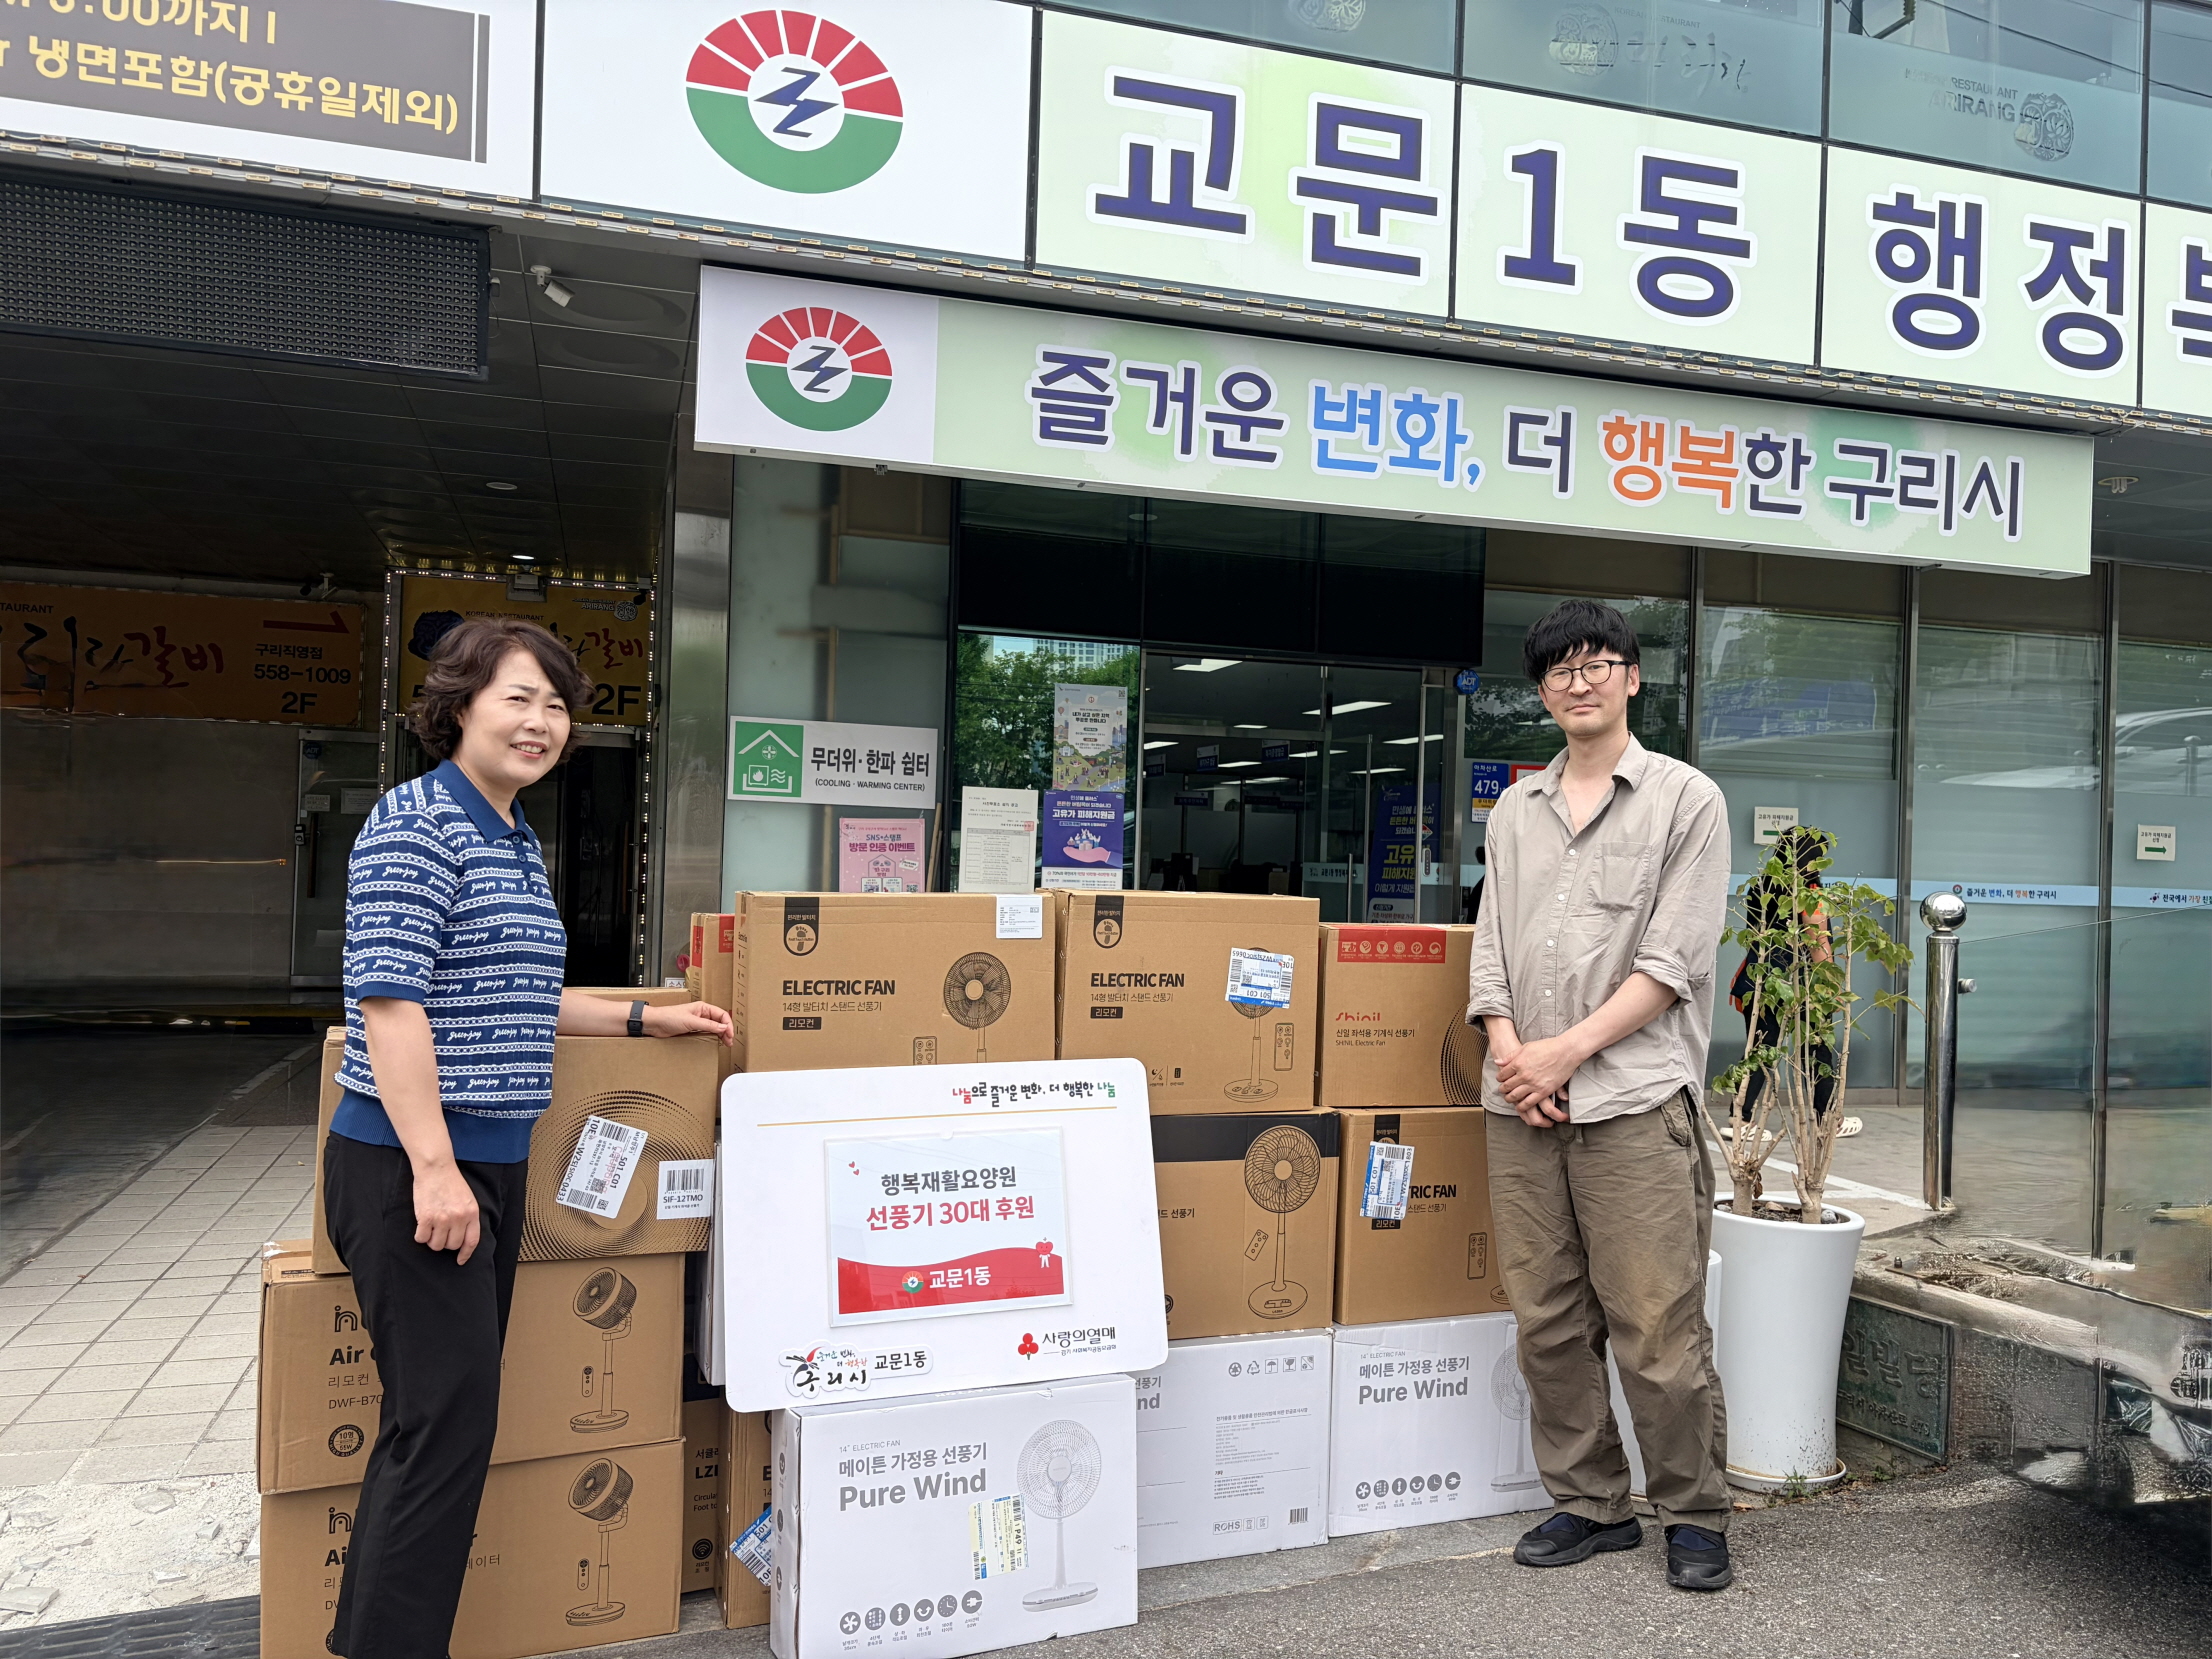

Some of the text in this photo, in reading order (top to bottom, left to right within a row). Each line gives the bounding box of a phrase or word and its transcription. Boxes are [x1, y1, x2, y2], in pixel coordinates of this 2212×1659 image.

[29, 35, 458, 134] 냉면포함(공휴일제외)
[1095, 75, 1751, 318] 교문1동
[1031, 350, 2021, 538] 즐거운 변화, 더 행복한 구리시
[465, 610, 495, 619] KOREAN
[580, 602, 614, 611] ARIRANG
[254, 643, 323, 660] 구리직영점
[253, 663, 351, 685] 558-1009
[1461, 678, 1476, 686] ADT
[281, 691, 318, 714] 2F
[592, 683, 642, 716] 2F
[901, 752, 929, 777] 쉼터
[1474, 765, 1498, 773] 아차산로
[815, 778, 926, 792] (COOLING WARMING CENTER)
[1474, 779, 1499, 795] 479
[1052, 809, 1115, 820] 고유가 피해지원금
[849, 842, 916, 853] 방문 인증 이벤트
[1384, 844, 1416, 865] 고유
[1967, 887, 2057, 900] 즐거운 변화, 더 행복한 구리시
[2162, 893, 2201, 904] 전국에서 가장
[783, 979, 895, 996] ELECTRIC FAN
[1091, 973, 1185, 988] ELECTRIC FAN
[1091, 993, 1174, 1003] 14형 발터치 스탠드 선풍기
[783, 1001, 882, 1013] 14형 발터치 스탠드 선풍기
[1095, 1008, 1117, 1017] 리모컨
[788, 1018, 814, 1028] 리모컨
[1335, 1012, 1381, 1021] Shinil
[1336, 1029, 1415, 1038] 신일 좌석용 기계식 선풍기
[952, 1081, 987, 1105] 나눔으로
[990, 1084, 1018, 1108] 즐거운
[1049, 1083, 1060, 1093] 더
[1062, 1081, 1094, 1099] 행복한
[1097, 1081, 1116, 1098] 나눔
[609, 1155, 628, 1190] 501 C01
[881, 1165, 1017, 1197] 행복재활요양원
[1433, 1184, 1457, 1198] FAN
[866, 1195, 1035, 1232] 선풍기 30대 후원
[1170, 1208, 1195, 1219] 선풍기
[1407, 1203, 1447, 1213] 스탠드 선풍기
[929, 1265, 991, 1289] 교문1동
[1041, 1326, 1116, 1349] 사랑의열매
[329, 1345, 365, 1366] Air
[874, 1350, 928, 1371] 교문1동
[1369, 1351, 1394, 1359] ELECTRIC
[1359, 1356, 1470, 1379] 메이튼 가정용 선풍기
[328, 1373, 369, 1388] 리모컨
[1359, 1376, 1468, 1405] Pure Wind
[852, 1441, 885, 1452] ELECTRIC
[886, 1439, 901, 1448] FAN
[839, 1442, 987, 1478] 메이튼 가정용 선풍기
[840, 1467, 986, 1512] Pure Wind
[693, 1503, 709, 1513] Foot
[324, 1546, 347, 1567] Ai
